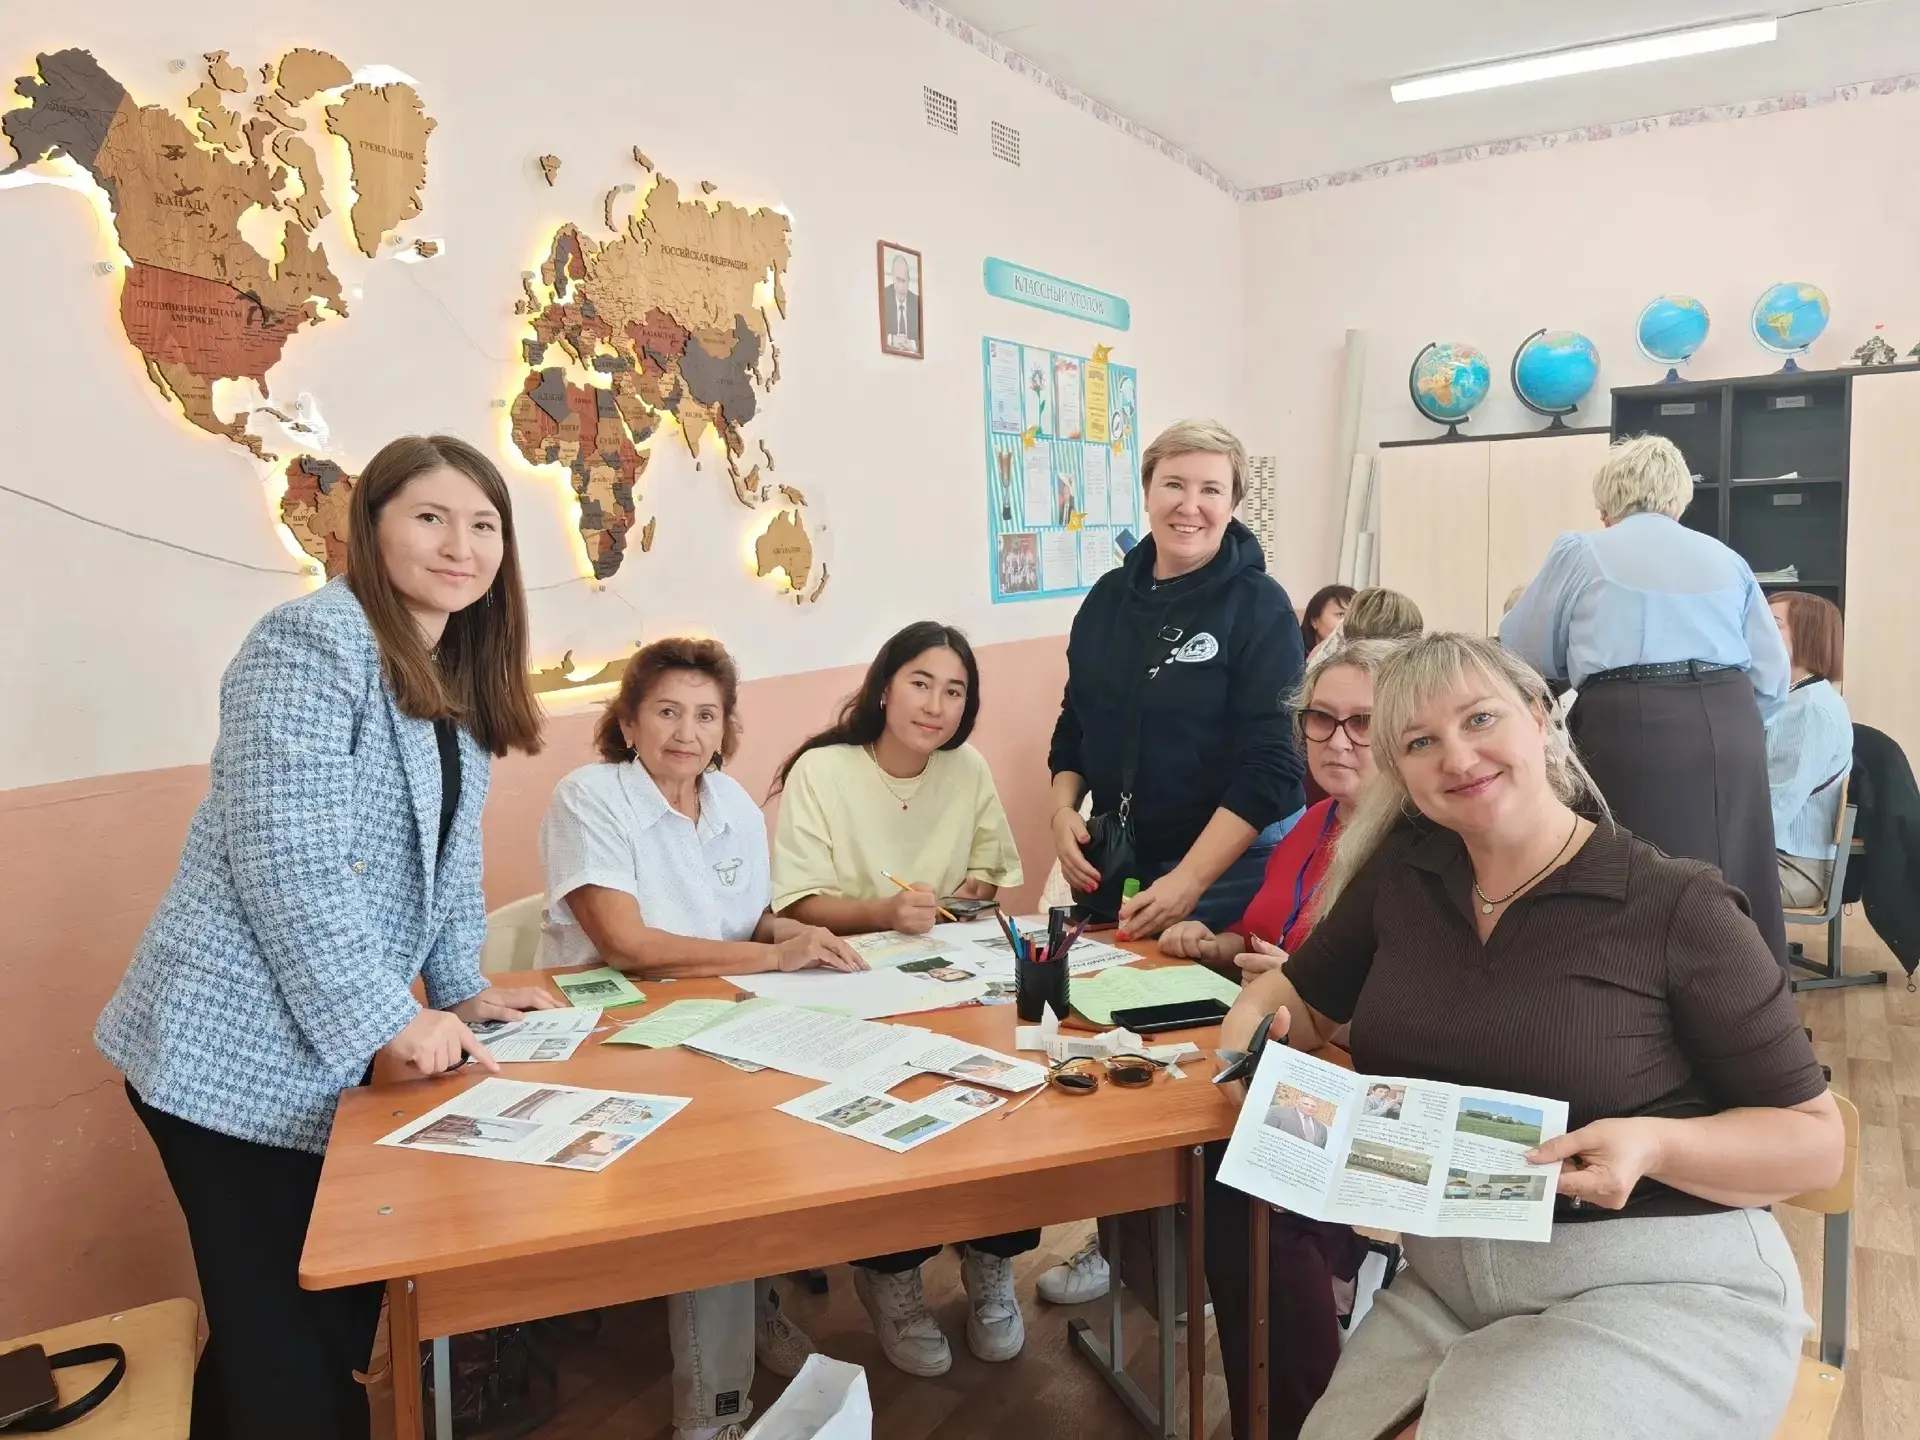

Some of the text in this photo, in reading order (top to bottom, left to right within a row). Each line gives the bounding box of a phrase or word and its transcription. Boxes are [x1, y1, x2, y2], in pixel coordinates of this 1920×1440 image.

[359, 140, 414, 160] ГРЕНЛАНДИЯ
[154, 192, 211, 212] КАНАДА
[661, 244, 748, 270] РОССИЙСКАЯ ФЕДЕРАЦИЯ
[1014, 274, 1104, 315] КЛАССНЫЙ УГОЛОК
[210, 307, 242, 318] ШТАТЫ
